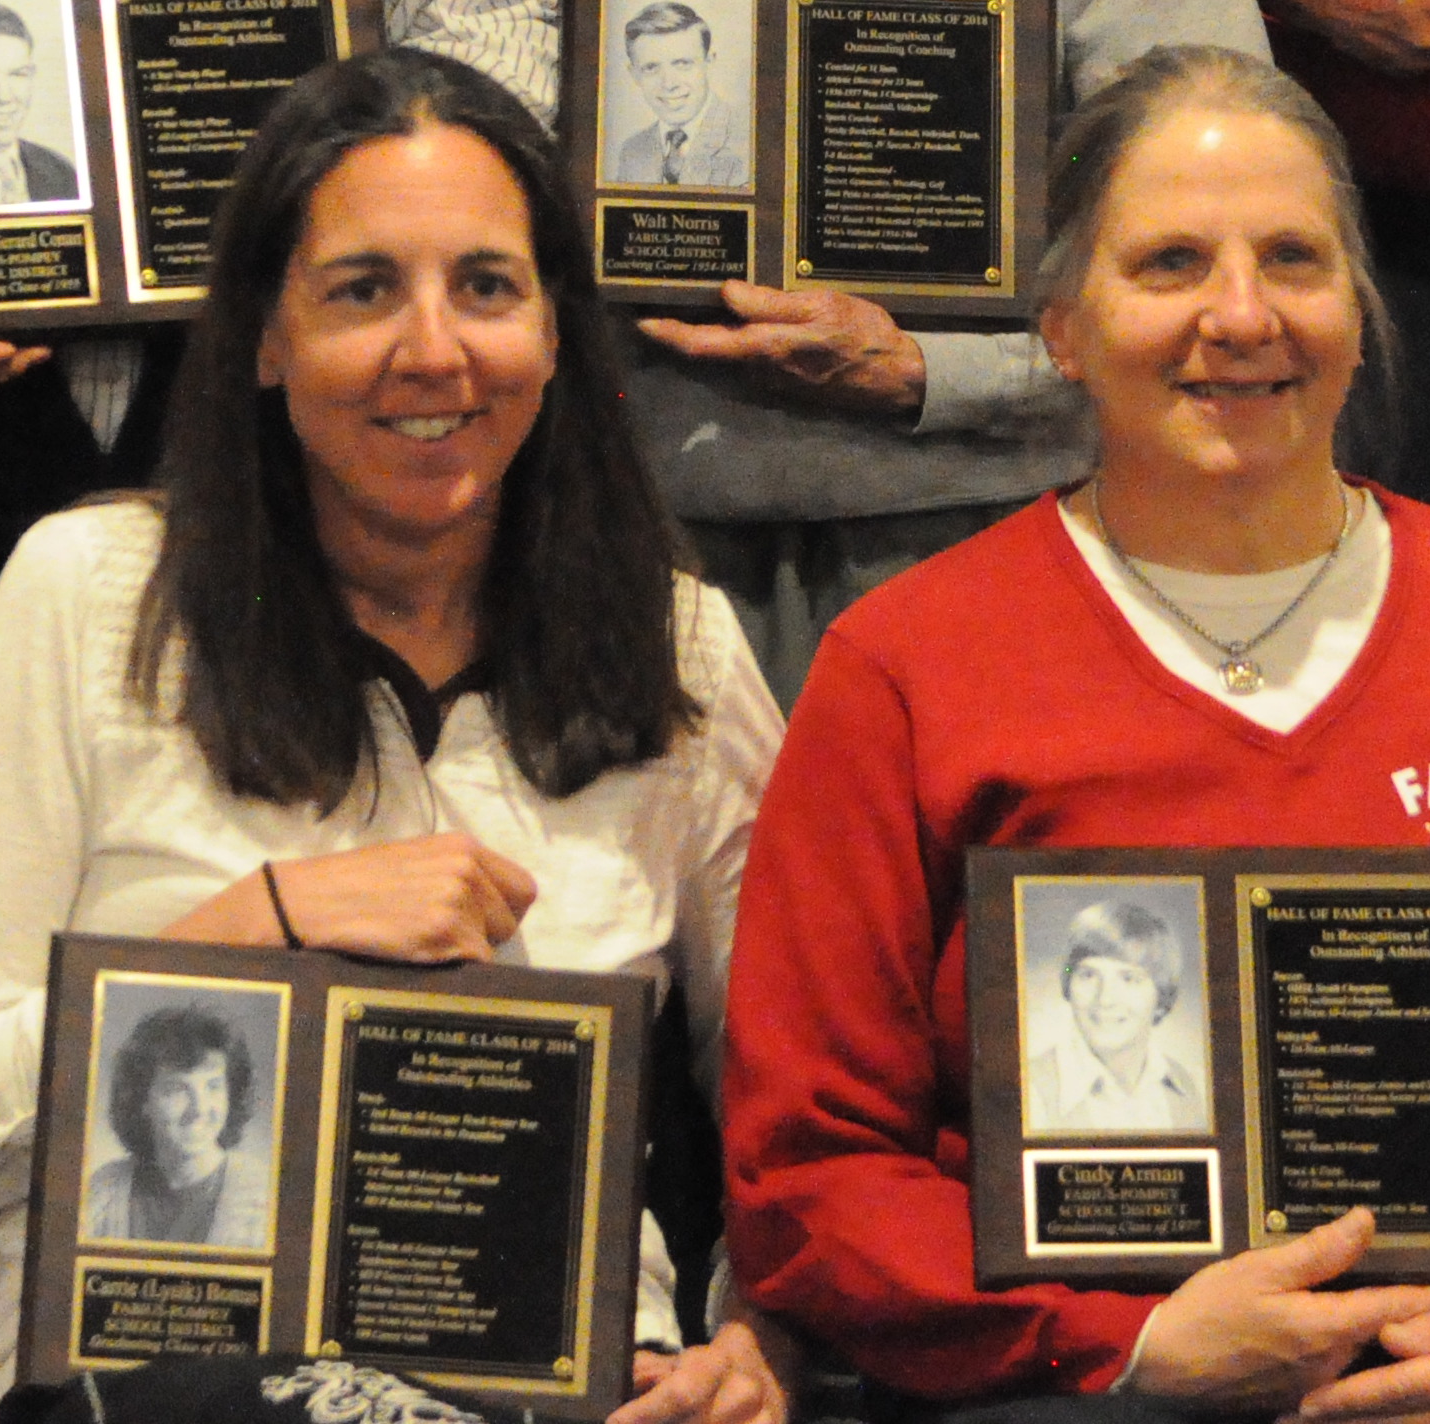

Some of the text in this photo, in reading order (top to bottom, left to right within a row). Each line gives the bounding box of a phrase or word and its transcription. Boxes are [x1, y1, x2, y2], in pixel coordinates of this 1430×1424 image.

[129, 3, 164, 15] HALL
[167, 2, 184, 13] OF
[187, 0, 221, 12] FAME
[812, 9, 988, 26] HALL OF FAME CLASS OF 2018
[857, 28, 945, 42] In Recognition of
[844, 42, 956, 58] Outstanding Coaching
[632, 212, 720, 231] Walt Norris
[623, 246, 728, 259] SCHOOL DISTRICT
[1267, 907, 1306, 921] HALL
[1309, 908, 1329, 920] OF
[1333, 907, 1371, 920] FAME
[1376, 907, 1423, 920] CLASS
[1414, 929, 1429, 941] of
[1058, 1164, 1184, 1185] Cindy Arman
